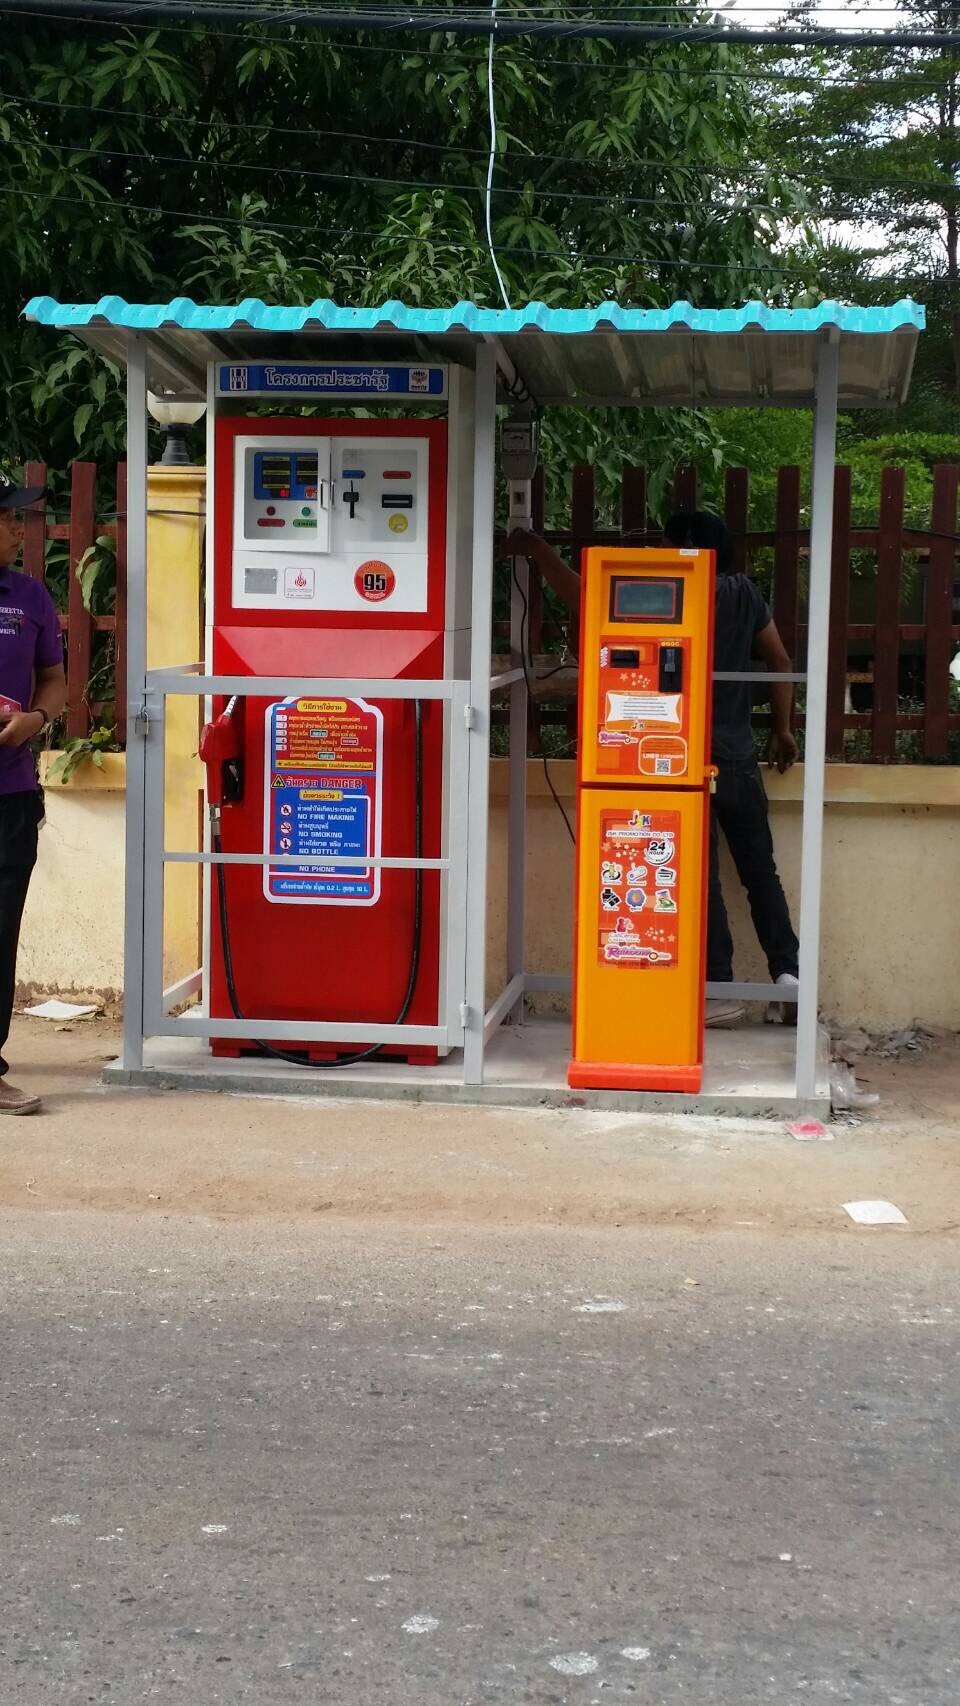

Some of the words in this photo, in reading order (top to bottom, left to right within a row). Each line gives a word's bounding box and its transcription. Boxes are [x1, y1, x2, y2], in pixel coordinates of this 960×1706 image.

[265, 367, 389, 391] โครงการประชารัฐ
[364, 573, 386, 591] 95
[304, 703, 342, 711] วิธีการใช้งาน
[285, 776, 318, 788] อันตราย
[320, 778, 362, 789] DANGER
[650, 842, 665, 851] 24
